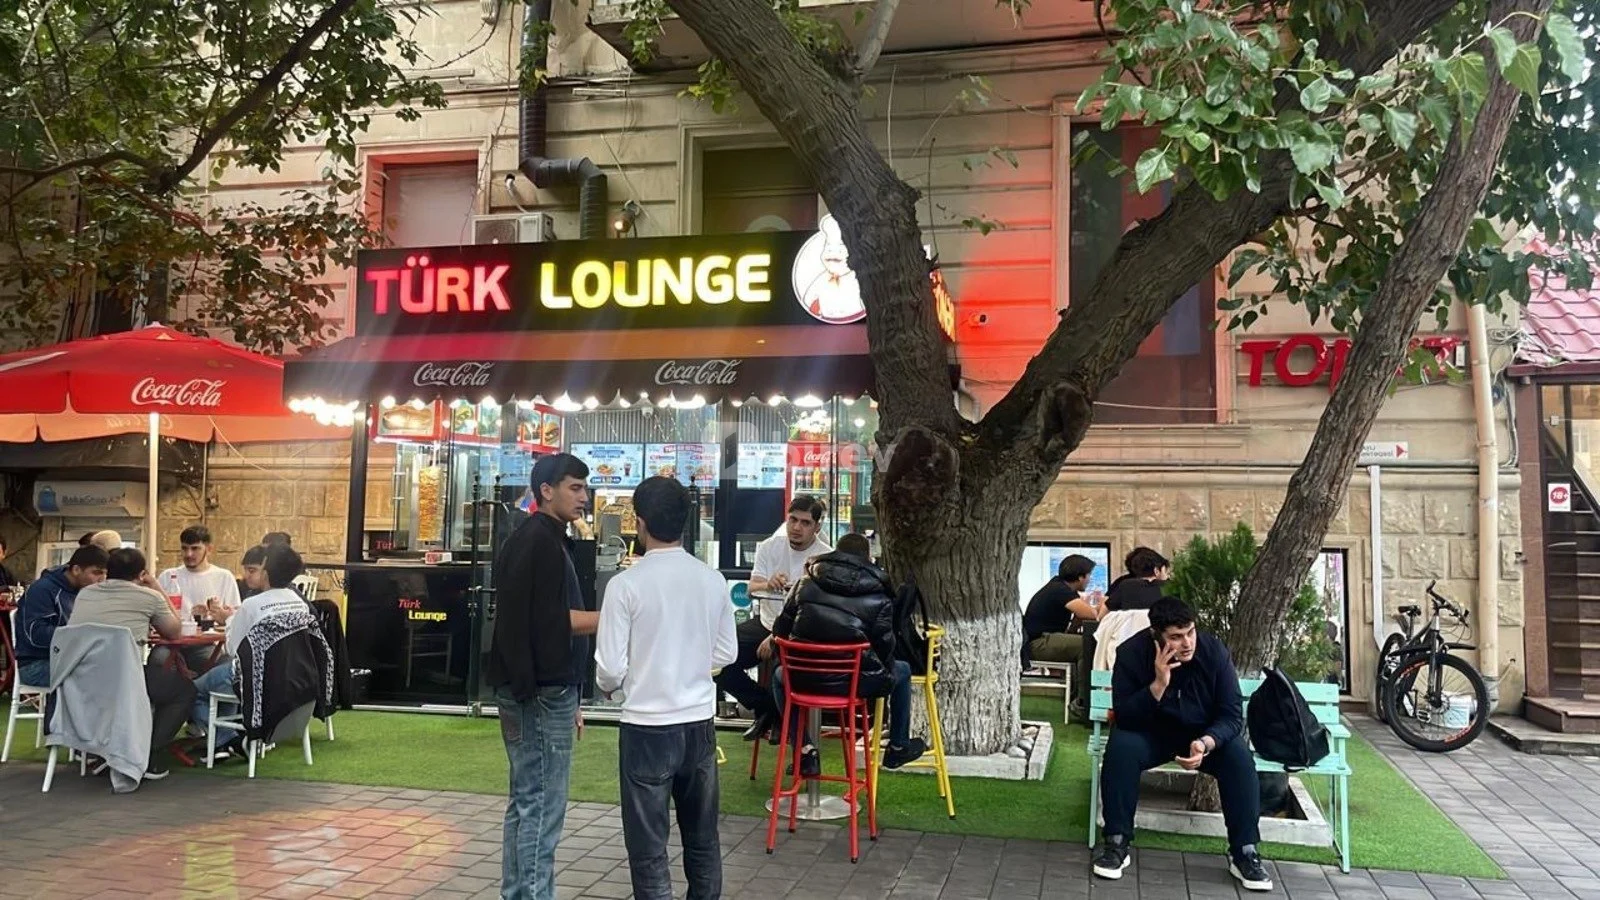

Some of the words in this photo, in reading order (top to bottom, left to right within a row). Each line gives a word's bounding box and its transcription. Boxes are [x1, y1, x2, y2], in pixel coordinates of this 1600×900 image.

[365, 255, 510, 314] TÜRK
[540, 254, 771, 309] LOUNGE
[413, 361, 495, 388] Coca-Cola
[654, 359, 743, 386] Coca-Cola
[131, 377, 227, 406] Coca-Cola
[398, 598, 421, 609] Türk
[408, 610, 447, 622] Lounge
